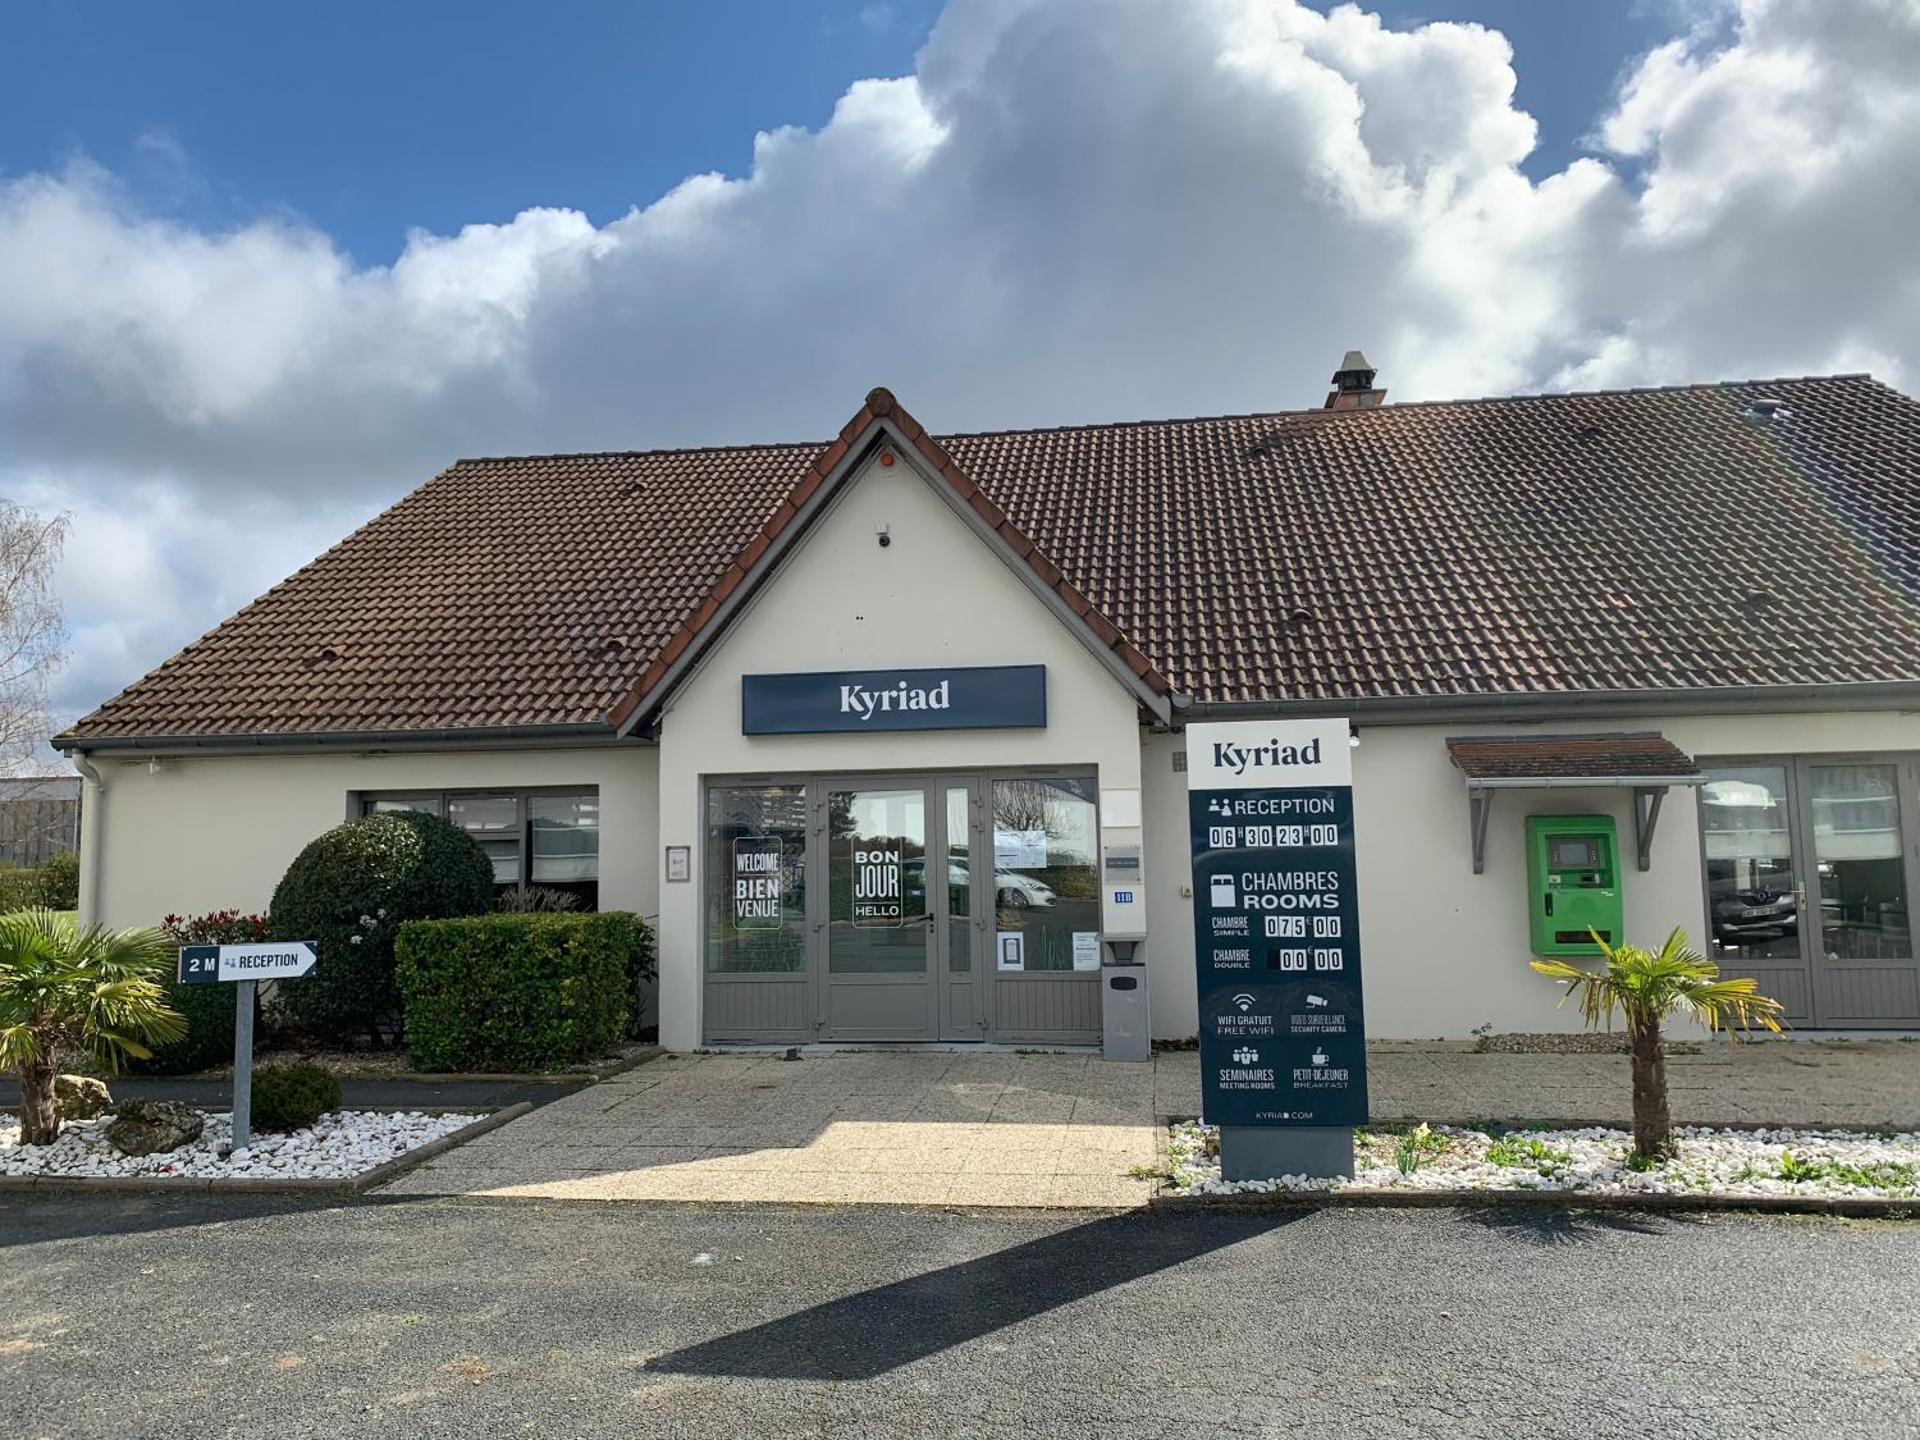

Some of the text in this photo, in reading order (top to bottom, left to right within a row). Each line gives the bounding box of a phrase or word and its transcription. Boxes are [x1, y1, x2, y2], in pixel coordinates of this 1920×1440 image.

[840, 680, 950, 720] Kyriad
[1213, 738, 1321, 775] Kyriad
[1234, 798, 1335, 815] RECEPTION
[736, 853, 779, 872] WELCOME
[854, 850, 899, 864] BON
[855, 865, 899, 898] JOUR
[1242, 871, 1339, 892] CHAMBRES
[736, 879, 779, 899] BIEN
[1116, 893, 1132, 903] 118
[1243, 893, 1340, 909] ROOMS
[736, 900, 779, 917] VENUE
[855, 905, 899, 916] HELLO
[1211, 916, 1249, 929] CHAMBRE
[1213, 929, 1250, 937] SIMPLE
[239, 954, 298, 968] RECEPTION
[1213, 949, 1250, 962] CHAMBRE
[189, 958, 215, 972] 2 M
[1217, 1015, 1272, 1025] WIFI GRATUIT
[1217, 1026, 1275, 1035] FREE WIFI
